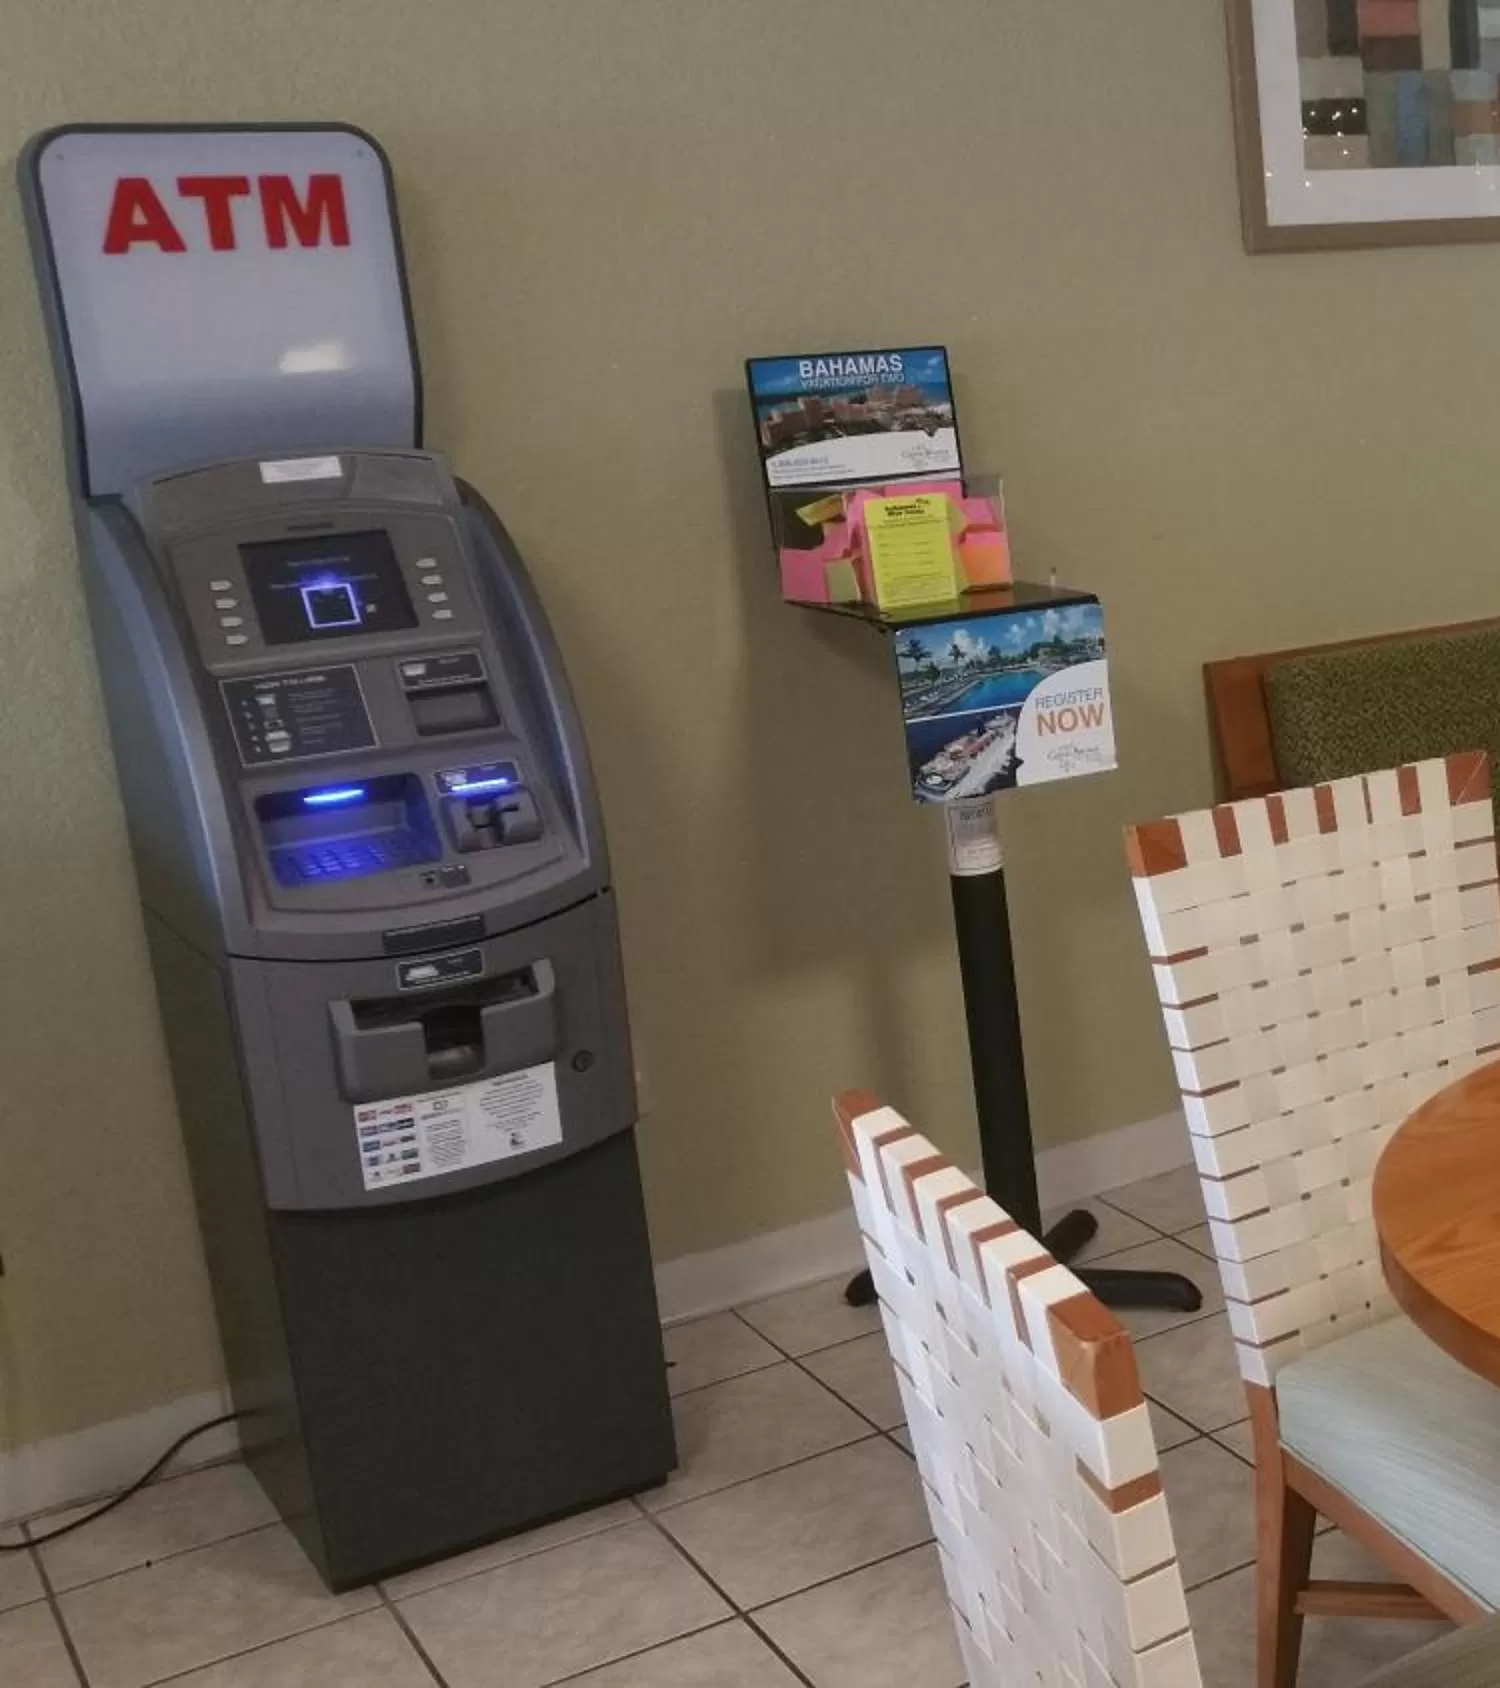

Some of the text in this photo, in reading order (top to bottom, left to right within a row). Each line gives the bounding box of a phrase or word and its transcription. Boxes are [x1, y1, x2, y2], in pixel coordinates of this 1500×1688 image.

[103, 174, 351, 254] ATM
[800, 354, 903, 378] BAHAMAS
[1035, 687, 1103, 710] REGISTER
[1037, 702, 1104, 737] NOW
